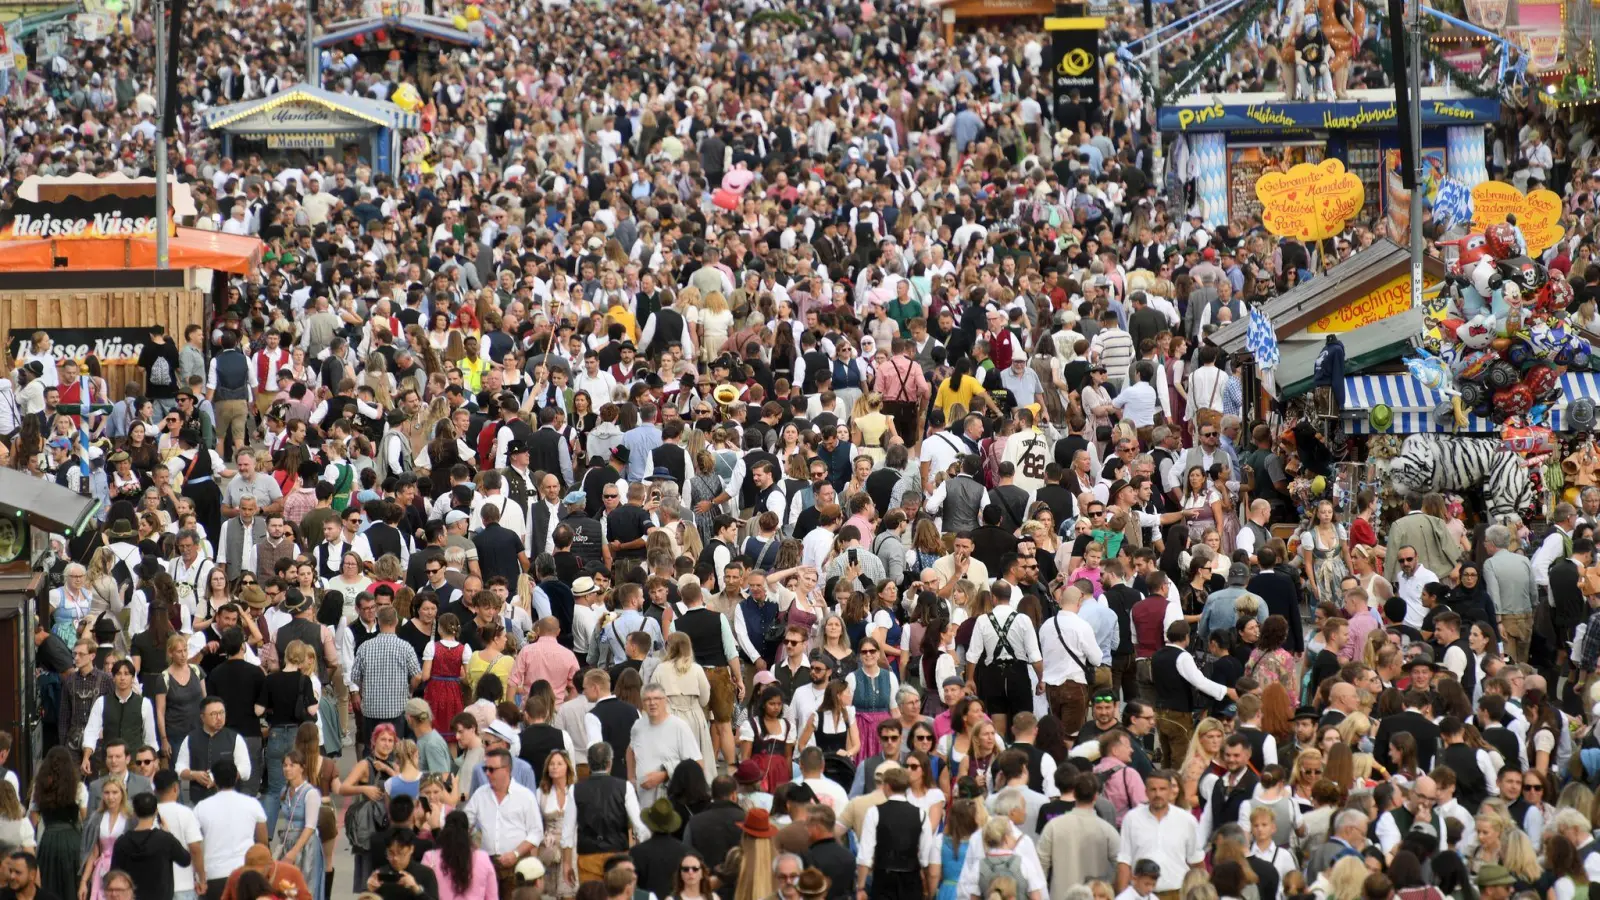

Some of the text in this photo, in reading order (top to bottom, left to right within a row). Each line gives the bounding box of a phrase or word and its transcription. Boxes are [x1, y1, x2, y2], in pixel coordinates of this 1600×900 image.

[271, 108, 328, 123] Mandeln
[1178, 103, 1225, 130] Pins
[1433, 101, 1475, 119] Tassen
[277, 137, 325, 147] Mandeln
[1263, 171, 1320, 192] Gebrannte
[1305, 177, 1355, 197] Mandeln
[12, 209, 157, 237] Heisse Nüsse
[16, 336, 145, 361] Hisse Nüss
[1023, 452, 1046, 479] 82
